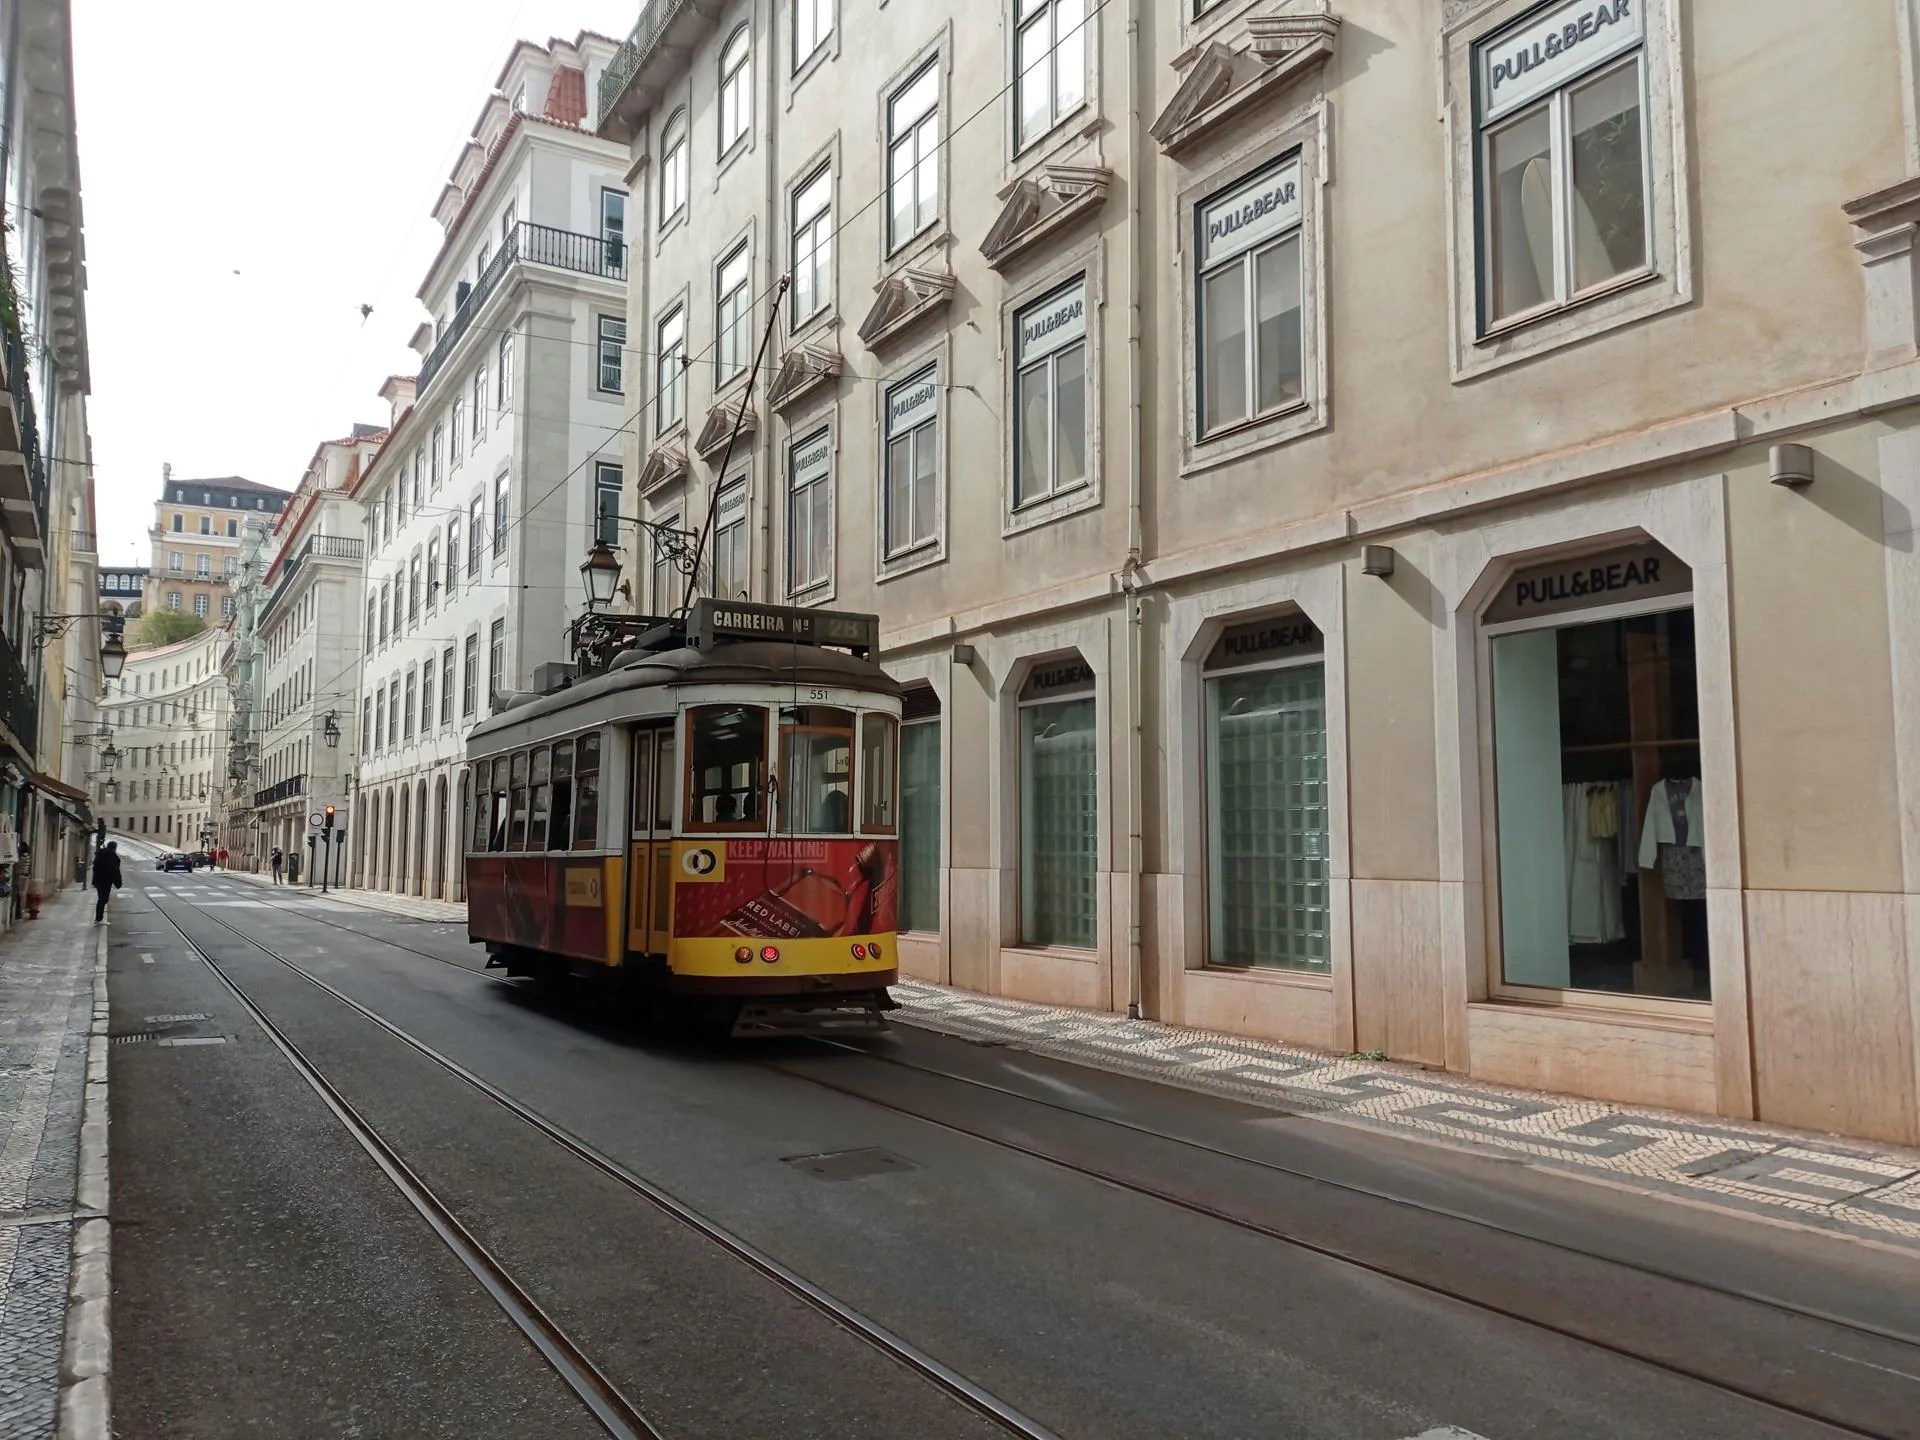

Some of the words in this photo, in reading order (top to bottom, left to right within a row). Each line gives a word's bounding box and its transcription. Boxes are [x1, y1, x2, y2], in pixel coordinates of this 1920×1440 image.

[1492, 0, 1630, 89] PULL&BEAR
[1209, 182, 1295, 243] PULL&BEAR
[1024, 300, 1083, 346] PULL&BEAR
[893, 384, 935, 419] PULL&BEAR
[1516, 558, 1660, 606] PULL&BEAR
[713, 610, 785, 632] CARREIRA
[1225, 623, 1313, 656] PULL&BEAR
[810, 690, 828, 700] 551
[729, 841, 762, 858] KEEP
[746, 901, 768, 917] RED
